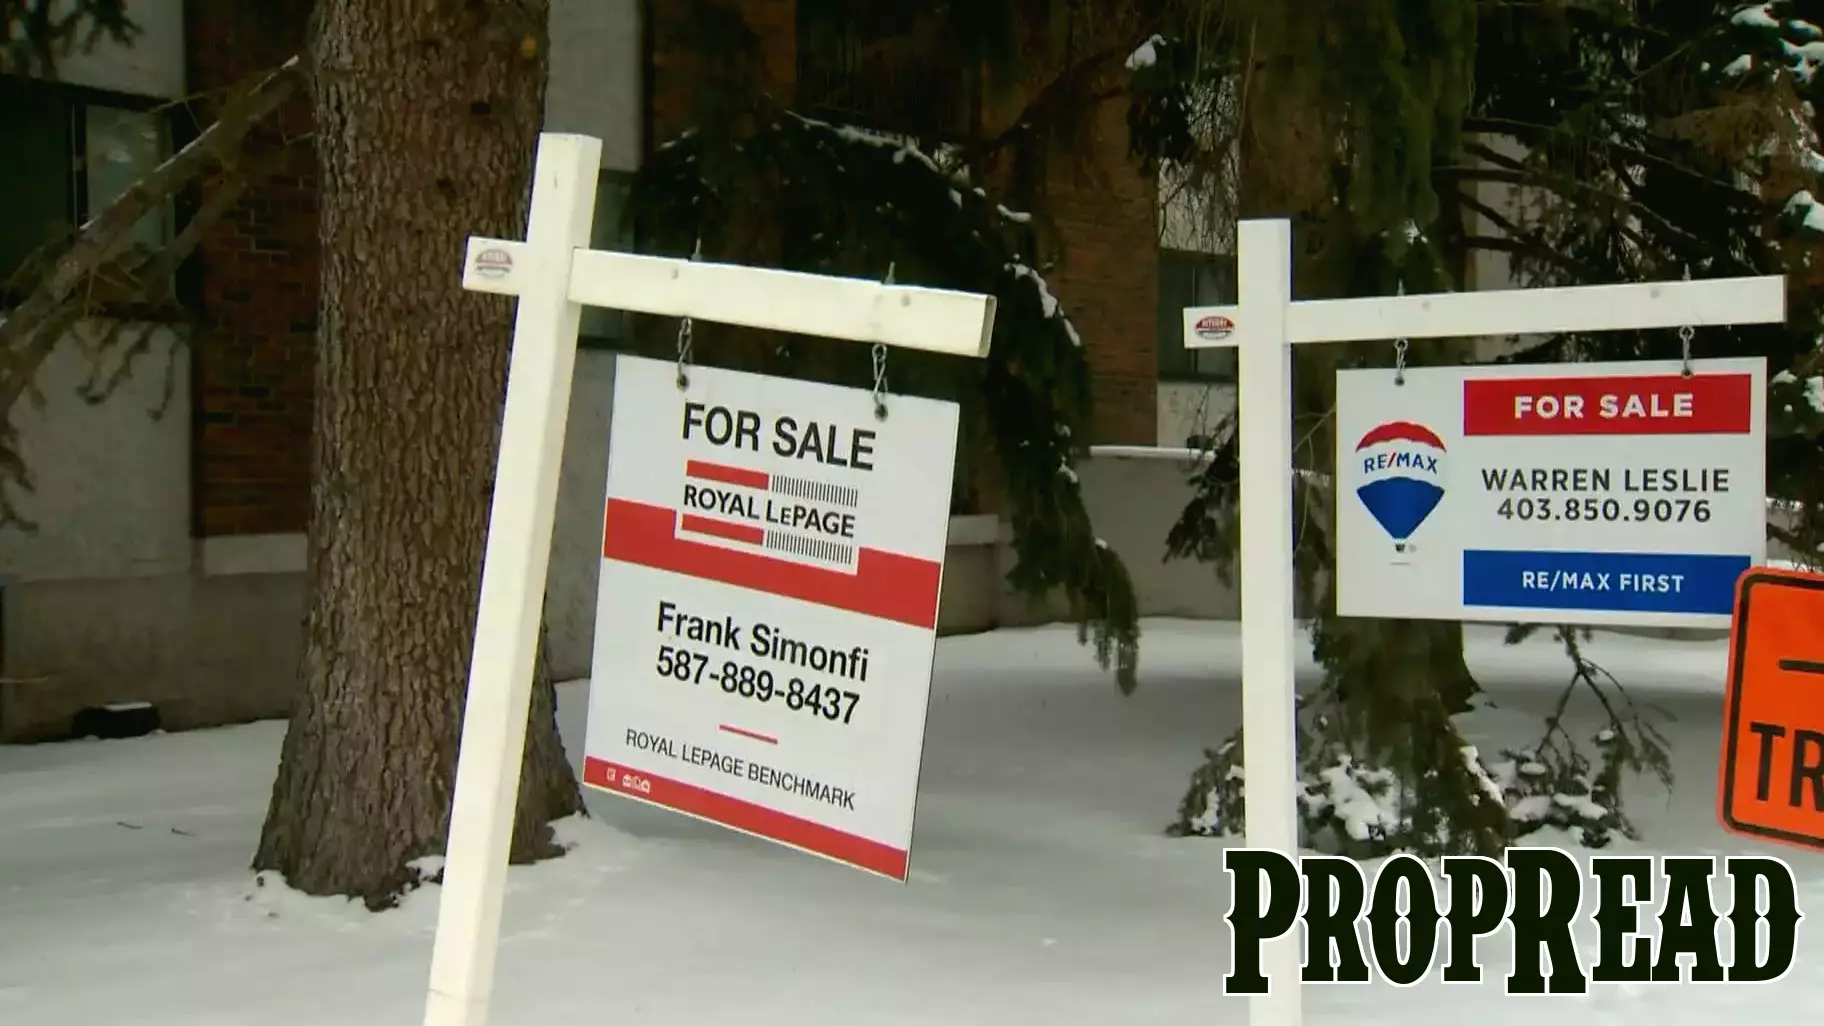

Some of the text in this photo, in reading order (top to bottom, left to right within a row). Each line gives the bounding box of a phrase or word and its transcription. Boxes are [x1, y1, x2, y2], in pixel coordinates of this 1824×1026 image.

[1514, 393, 1694, 420] FOR SALE
[682, 402, 876, 472] FOR SALE
[1363, 452, 1438, 475] RE/MAX
[1481, 468, 1730, 492] WARREN LESLIE
[683, 484, 760, 521] ROYAL
[1497, 498, 1711, 523] 403.850.9076
[1522, 570, 1685, 594] RE/MAX FIRST
[657, 600, 869, 682] Frank Simonfi
[656, 645, 861, 725] 587-889-8437
[625, 728, 856, 811] ROYAL LEPAGE BENCHMARK
